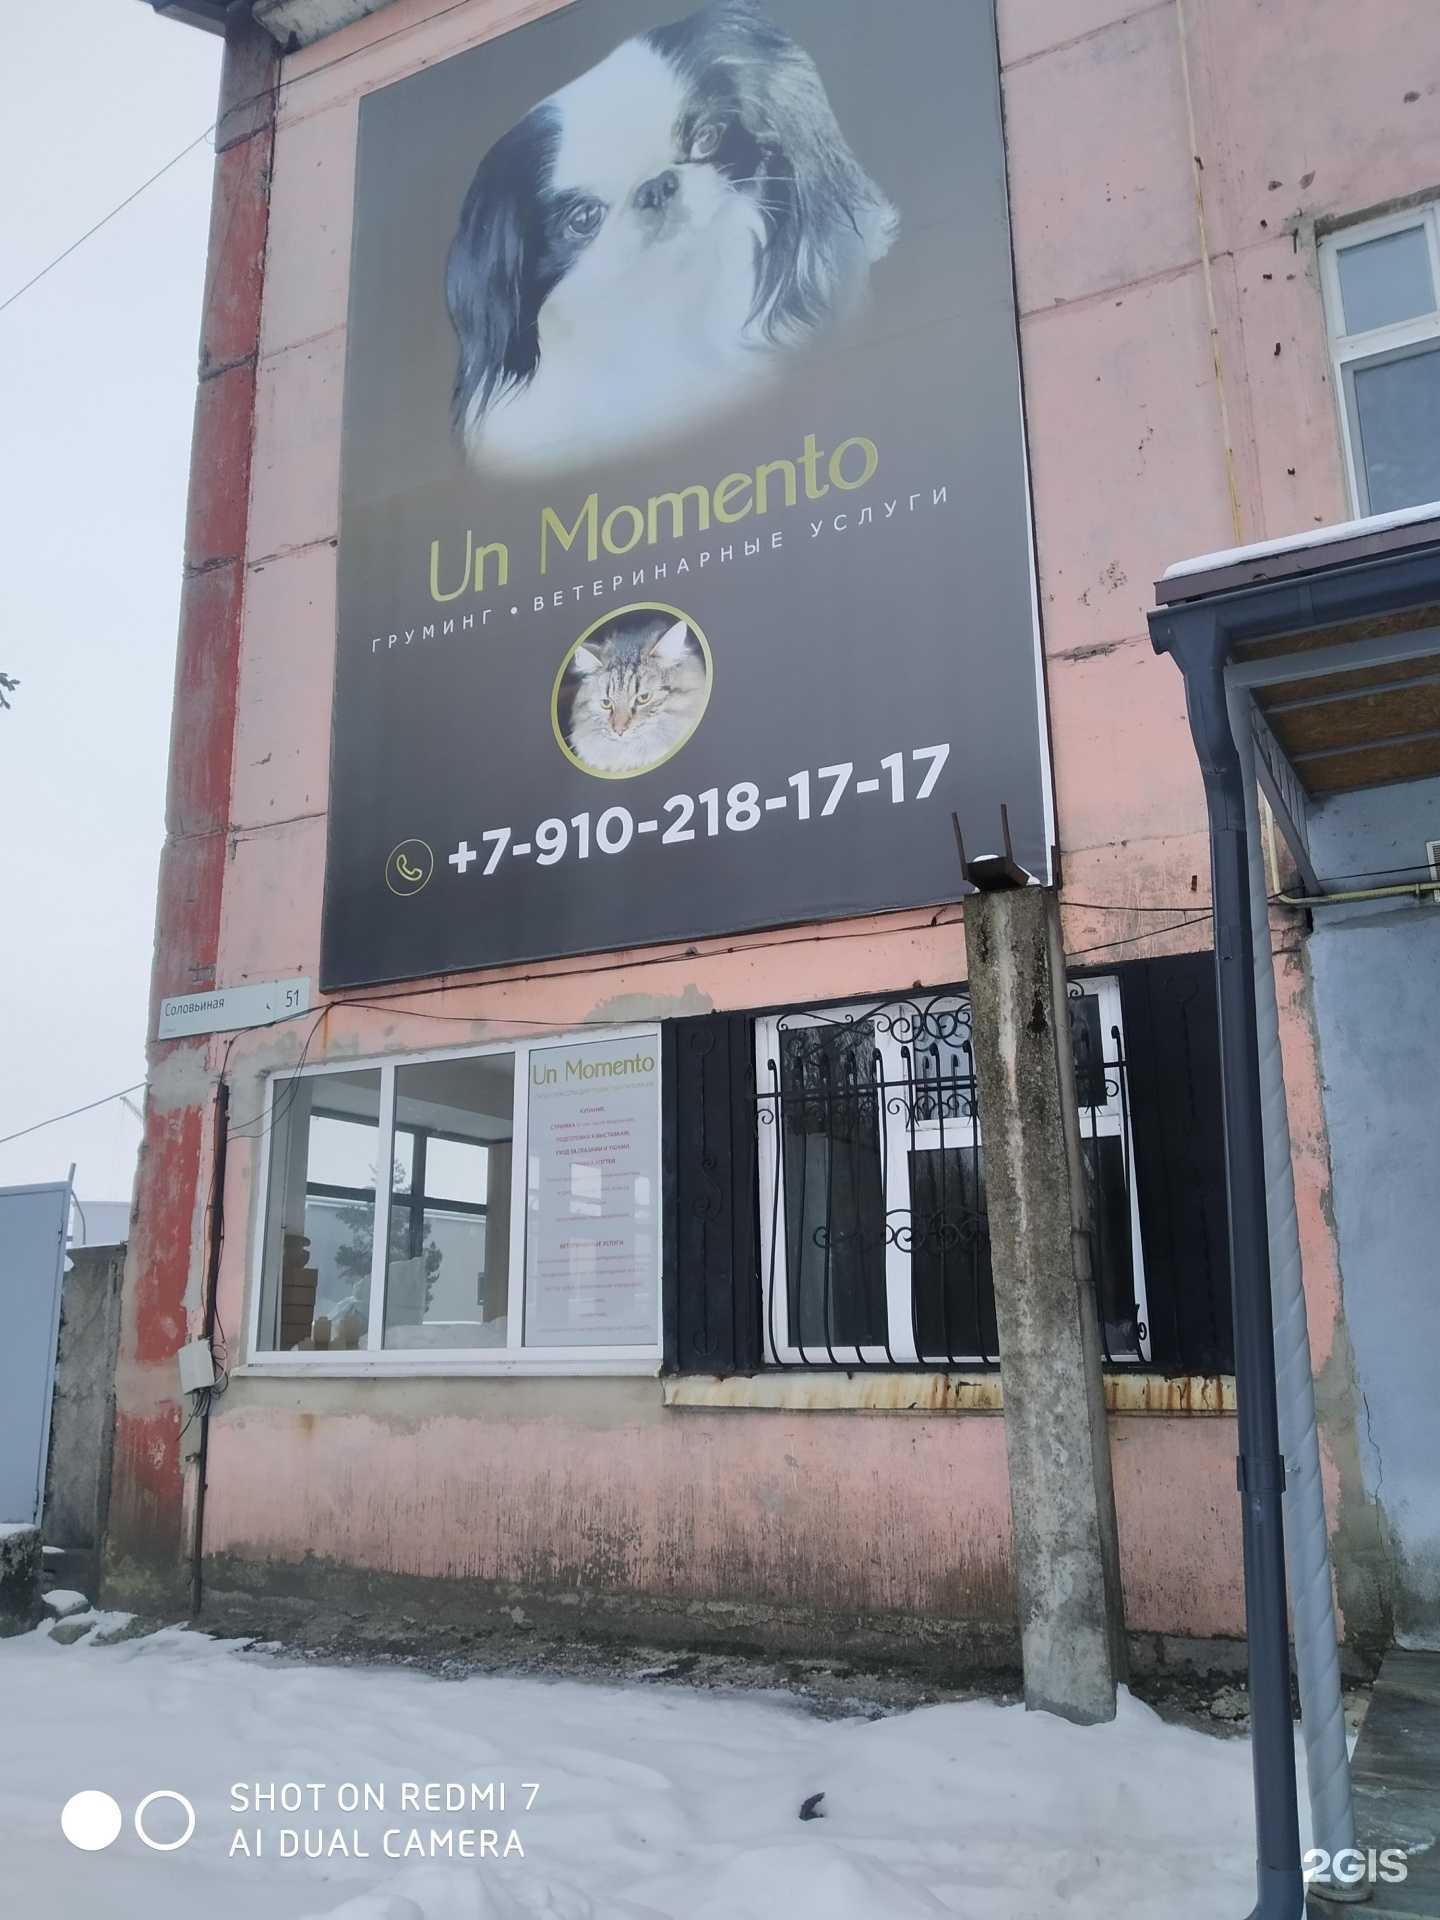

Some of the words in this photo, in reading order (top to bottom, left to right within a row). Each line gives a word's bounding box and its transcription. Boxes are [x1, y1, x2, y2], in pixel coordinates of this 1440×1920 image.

[371, 608, 495, 653] ГРУМИНГ
[533, 530, 784, 612] ВЕТЕРИНАРНЫЕ
[809, 486, 949, 538] УСЛУГИ
[429, 529, 509, 603] Un
[540, 433, 879, 575] Momento
[448, 743, 950, 876] +7-910-218-17-17
[165, 998, 225, 1017] Соловьиная
[285, 989, 300, 1008] 51
[533, 1064, 557, 1085] Un
[566, 1054, 655, 1081] Momento
